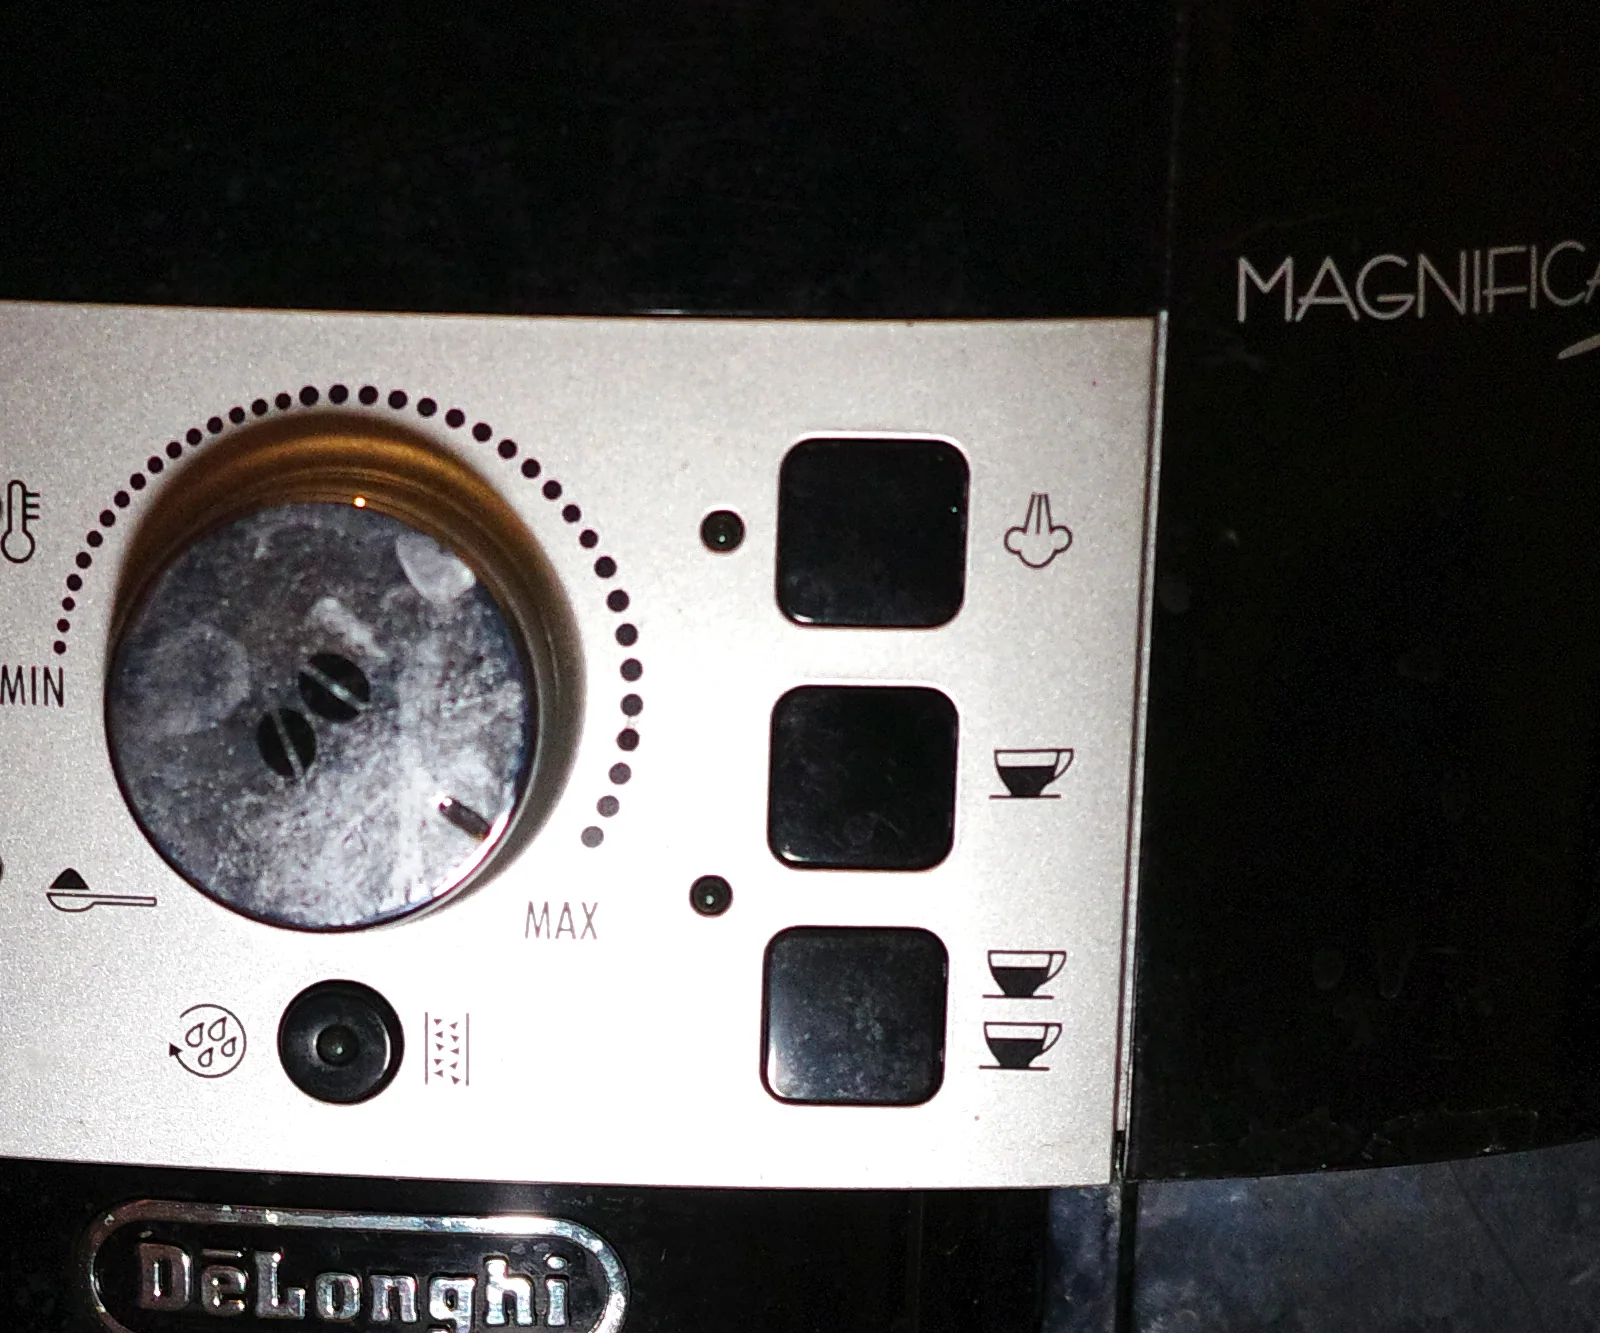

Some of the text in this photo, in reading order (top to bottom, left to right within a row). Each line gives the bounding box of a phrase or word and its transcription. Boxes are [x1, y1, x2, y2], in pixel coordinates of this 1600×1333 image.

[1236, 239, 1600, 324] MAGNIFIC
[0, 664, 66, 708] MIN
[523, 901, 599, 941] MAX
